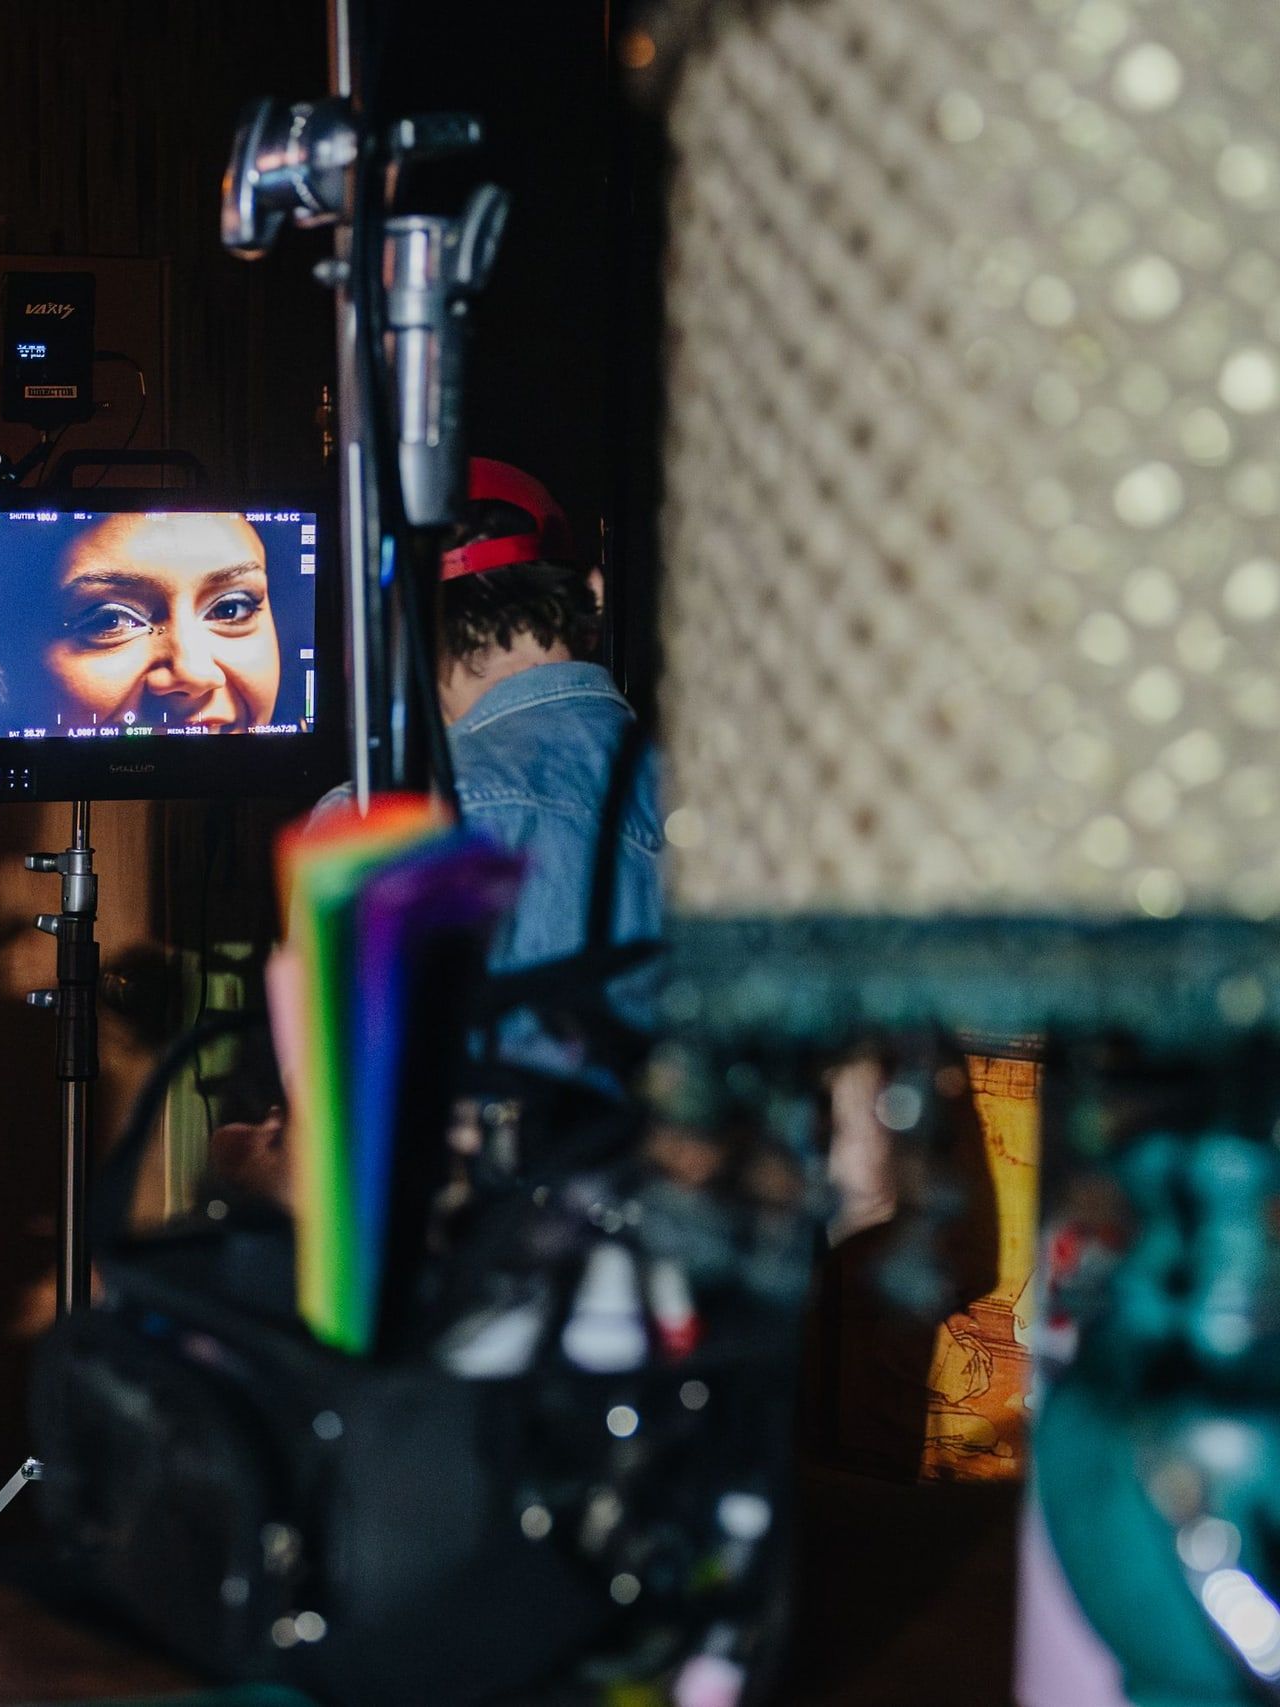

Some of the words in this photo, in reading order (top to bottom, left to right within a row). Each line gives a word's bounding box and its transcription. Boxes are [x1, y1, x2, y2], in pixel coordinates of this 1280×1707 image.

[9, 512, 35, 520] SHUTTER
[289, 513, 300, 522] CC
[133, 727, 153, 736] STBY
